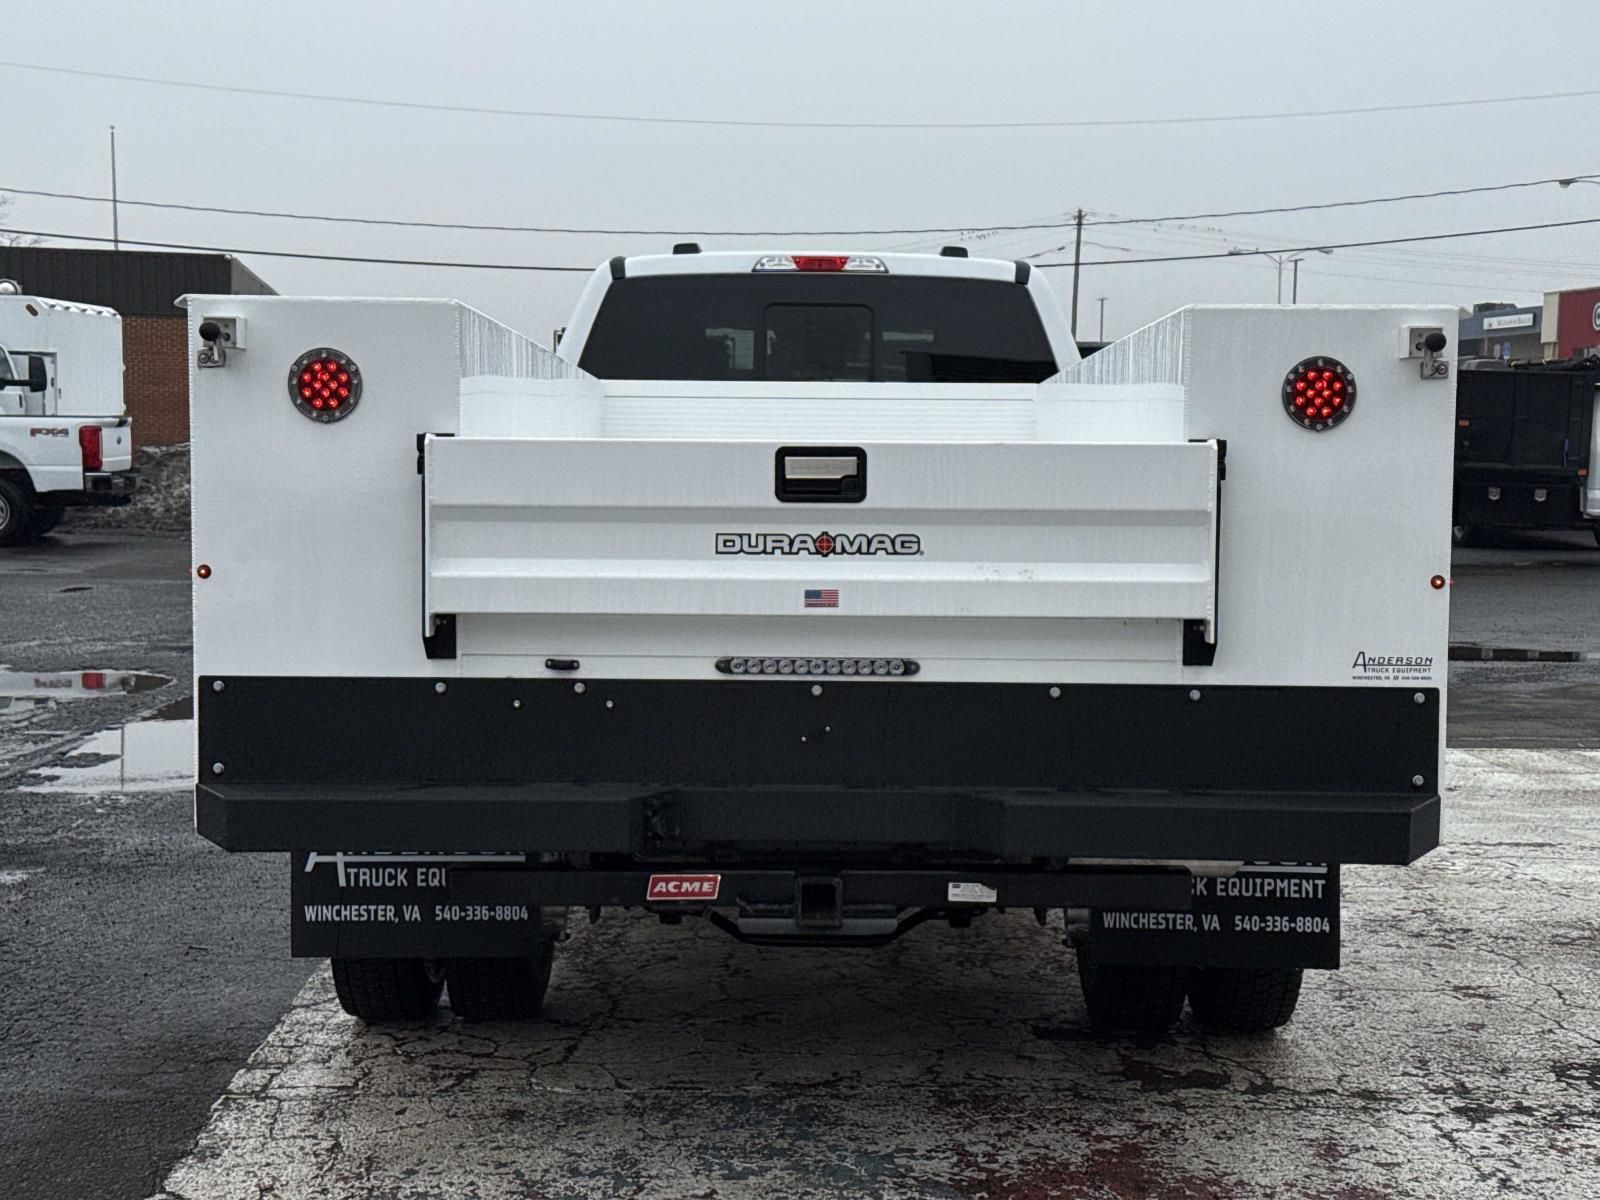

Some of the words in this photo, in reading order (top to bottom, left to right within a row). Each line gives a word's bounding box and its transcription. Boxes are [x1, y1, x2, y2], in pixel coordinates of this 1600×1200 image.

[1352, 651, 1433, 673] ANDERSON
[346, 868, 409, 887] TRUCK
[653, 881, 715, 893] ACME
[1216, 877, 1326, 898] EQUIPMENT
[304, 904, 399, 924] WINCHESTER,
[402, 904, 422, 922] VA
[435, 905, 529, 922] 540-336-8804
[1102, 912, 1198, 932] WINCHESTER,
[1202, 914, 1221, 932] VA
[1234, 915, 1331, 934] 540-336-8804
